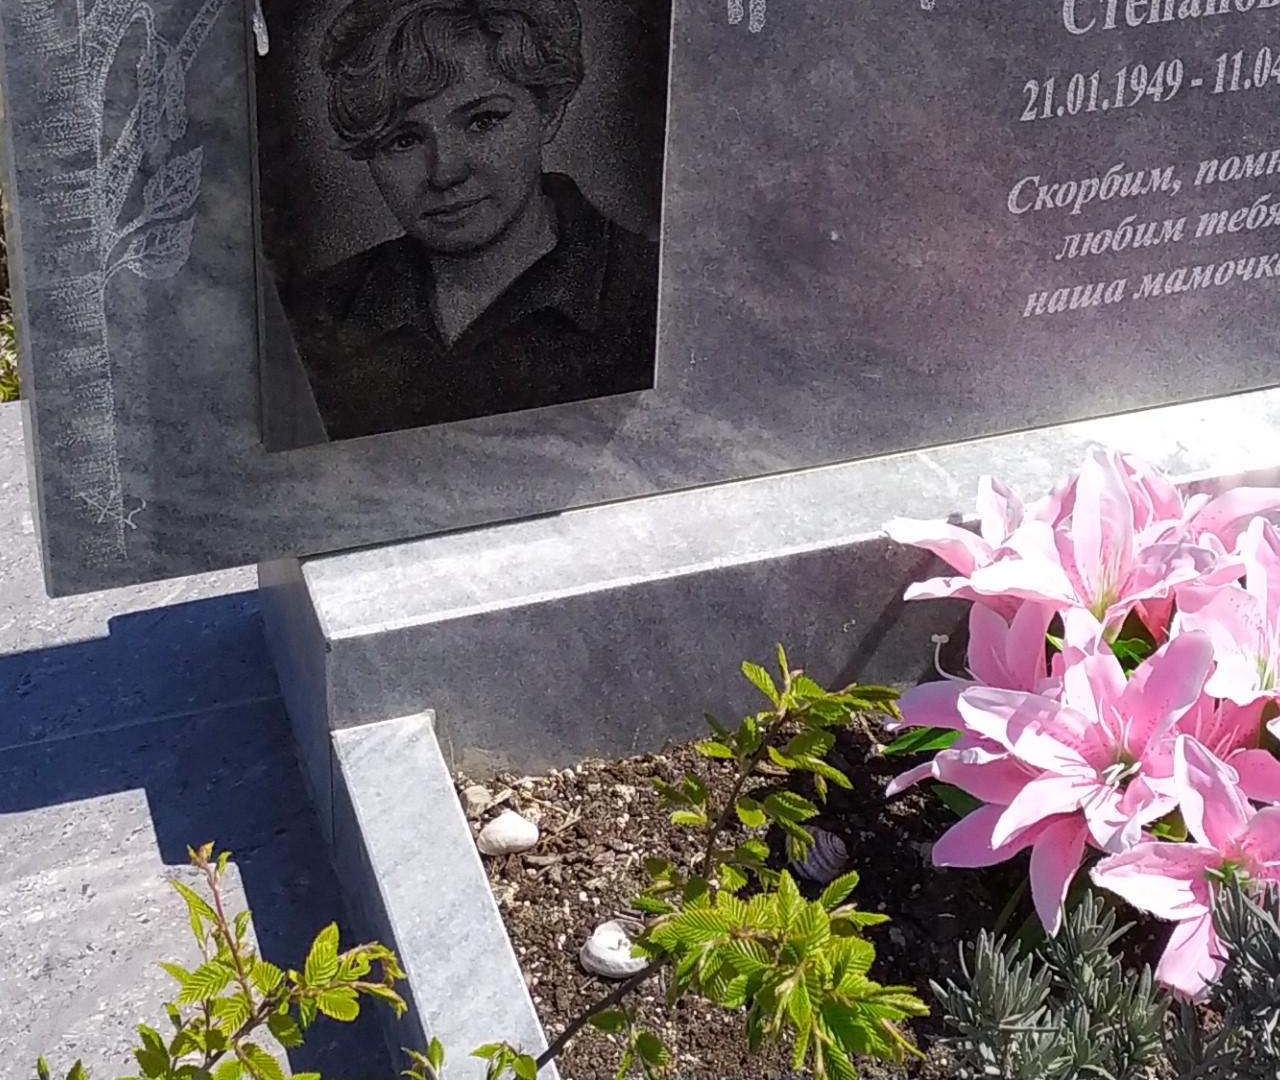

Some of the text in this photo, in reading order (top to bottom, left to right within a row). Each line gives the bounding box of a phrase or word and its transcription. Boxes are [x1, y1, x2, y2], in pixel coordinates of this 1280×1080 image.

[1020, 59, 1184, 121] 21.01.1949
[1006, 163, 1183, 215] Скорбим,
[1056, 215, 1186, 261] любим
[1023, 282, 1126, 317] наша
